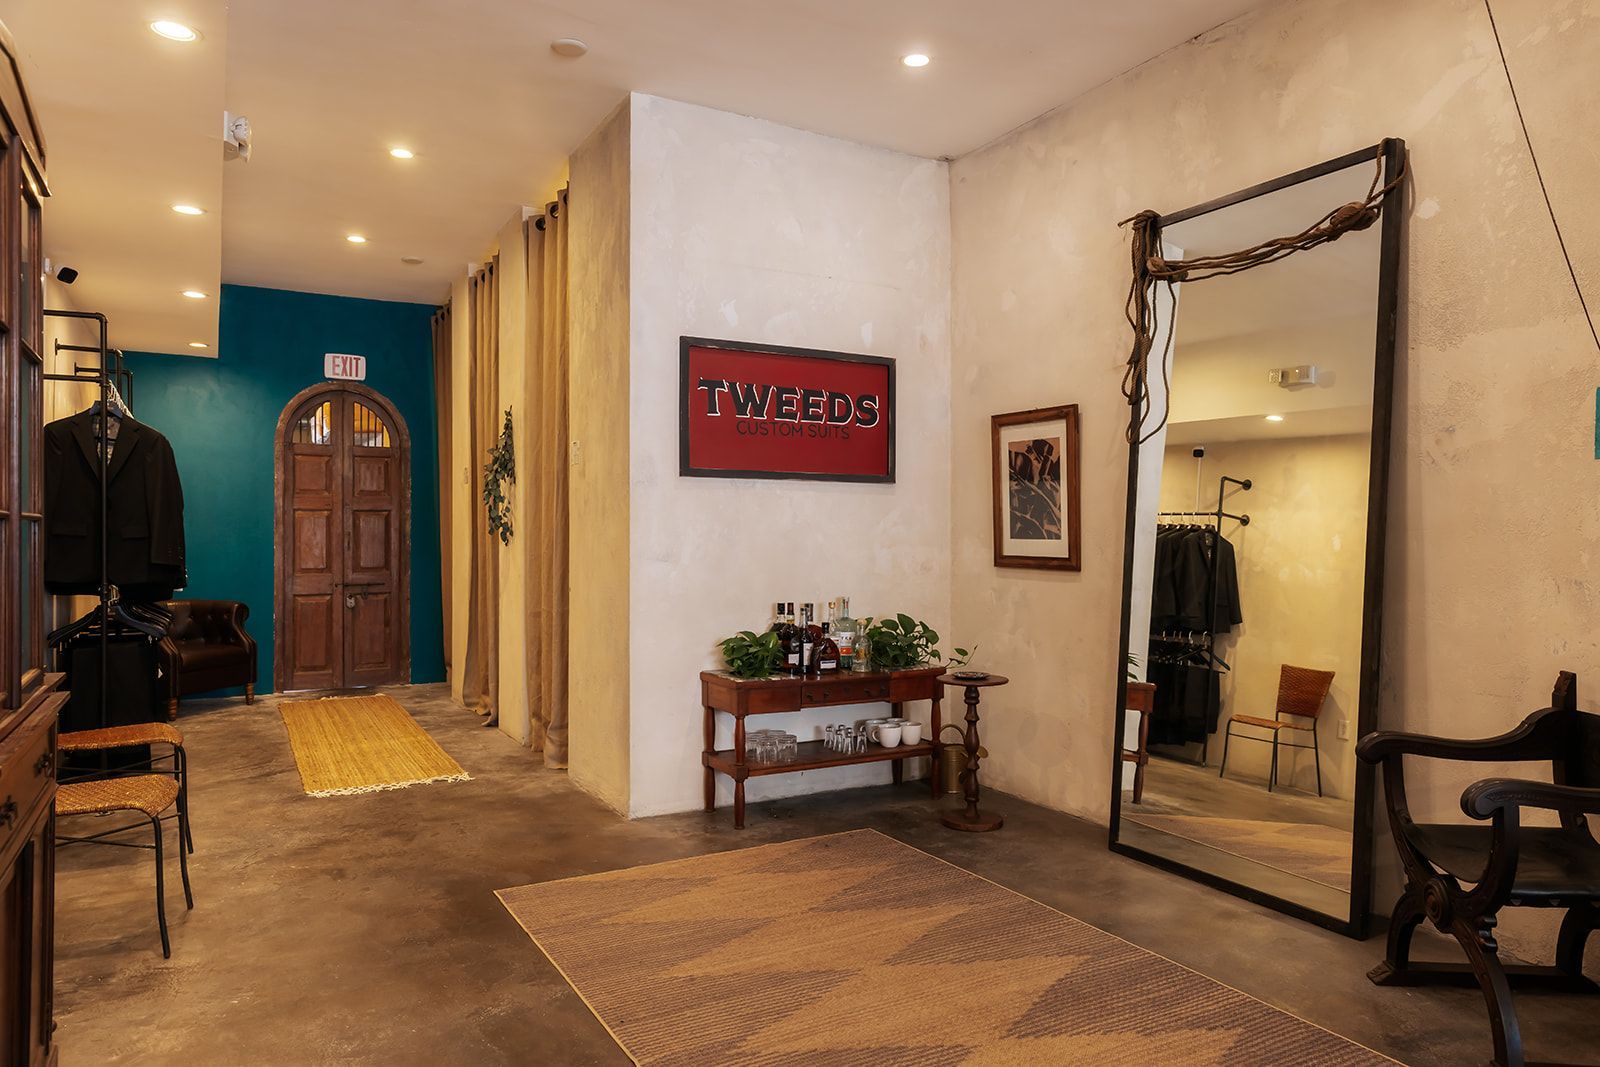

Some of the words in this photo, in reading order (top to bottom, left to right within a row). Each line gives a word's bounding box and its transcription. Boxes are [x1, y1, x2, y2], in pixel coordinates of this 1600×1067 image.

[332, 355, 361, 378] EXIT
[697, 377, 879, 428] TWEEDS
[736, 421, 803, 438] CUSTOM
[808, 424, 849, 439] SUITS
